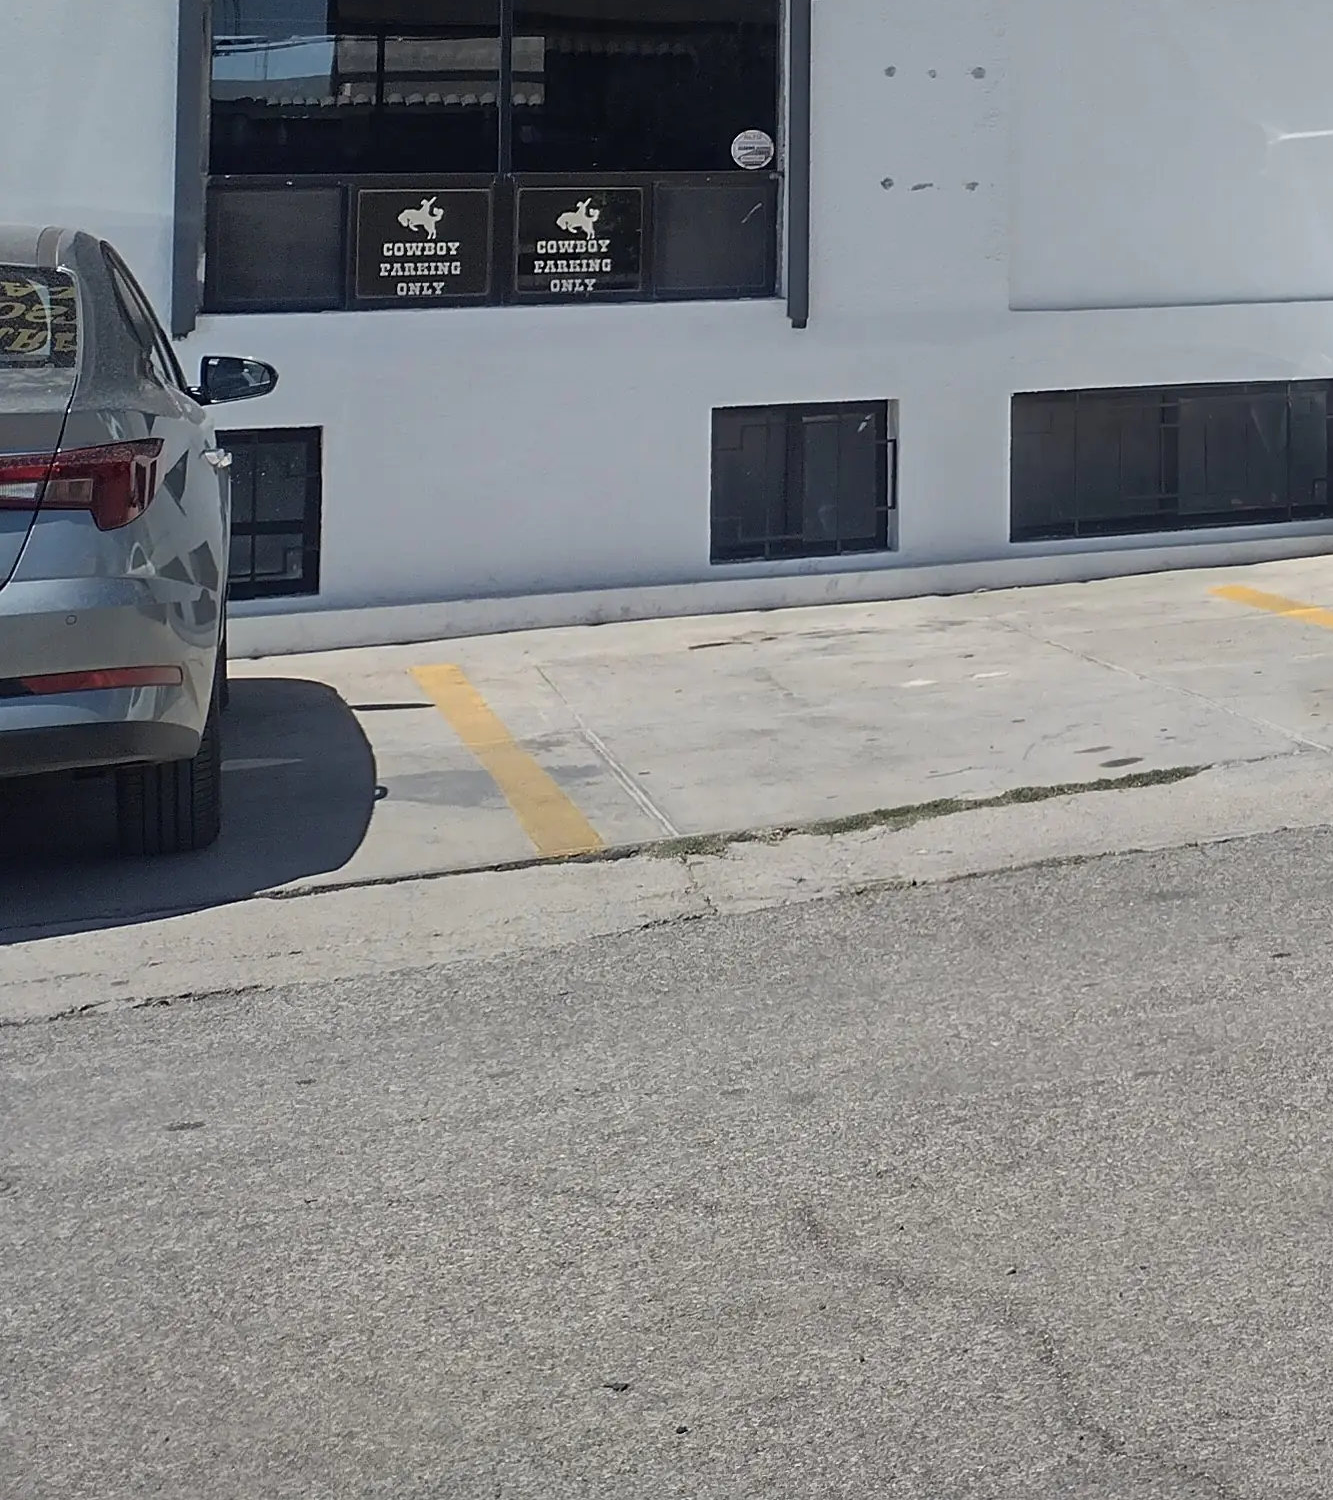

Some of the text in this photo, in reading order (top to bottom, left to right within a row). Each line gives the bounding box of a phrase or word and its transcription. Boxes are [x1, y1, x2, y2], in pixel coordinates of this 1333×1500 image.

[383, 241, 460, 256] COWBOY
[536, 239, 611, 254] COWBOY
[379, 262, 461, 277] PARKING
[533, 258, 612, 274] PARKING
[396, 281, 445, 296] ONLY
[550, 278, 597, 293] ONLY
